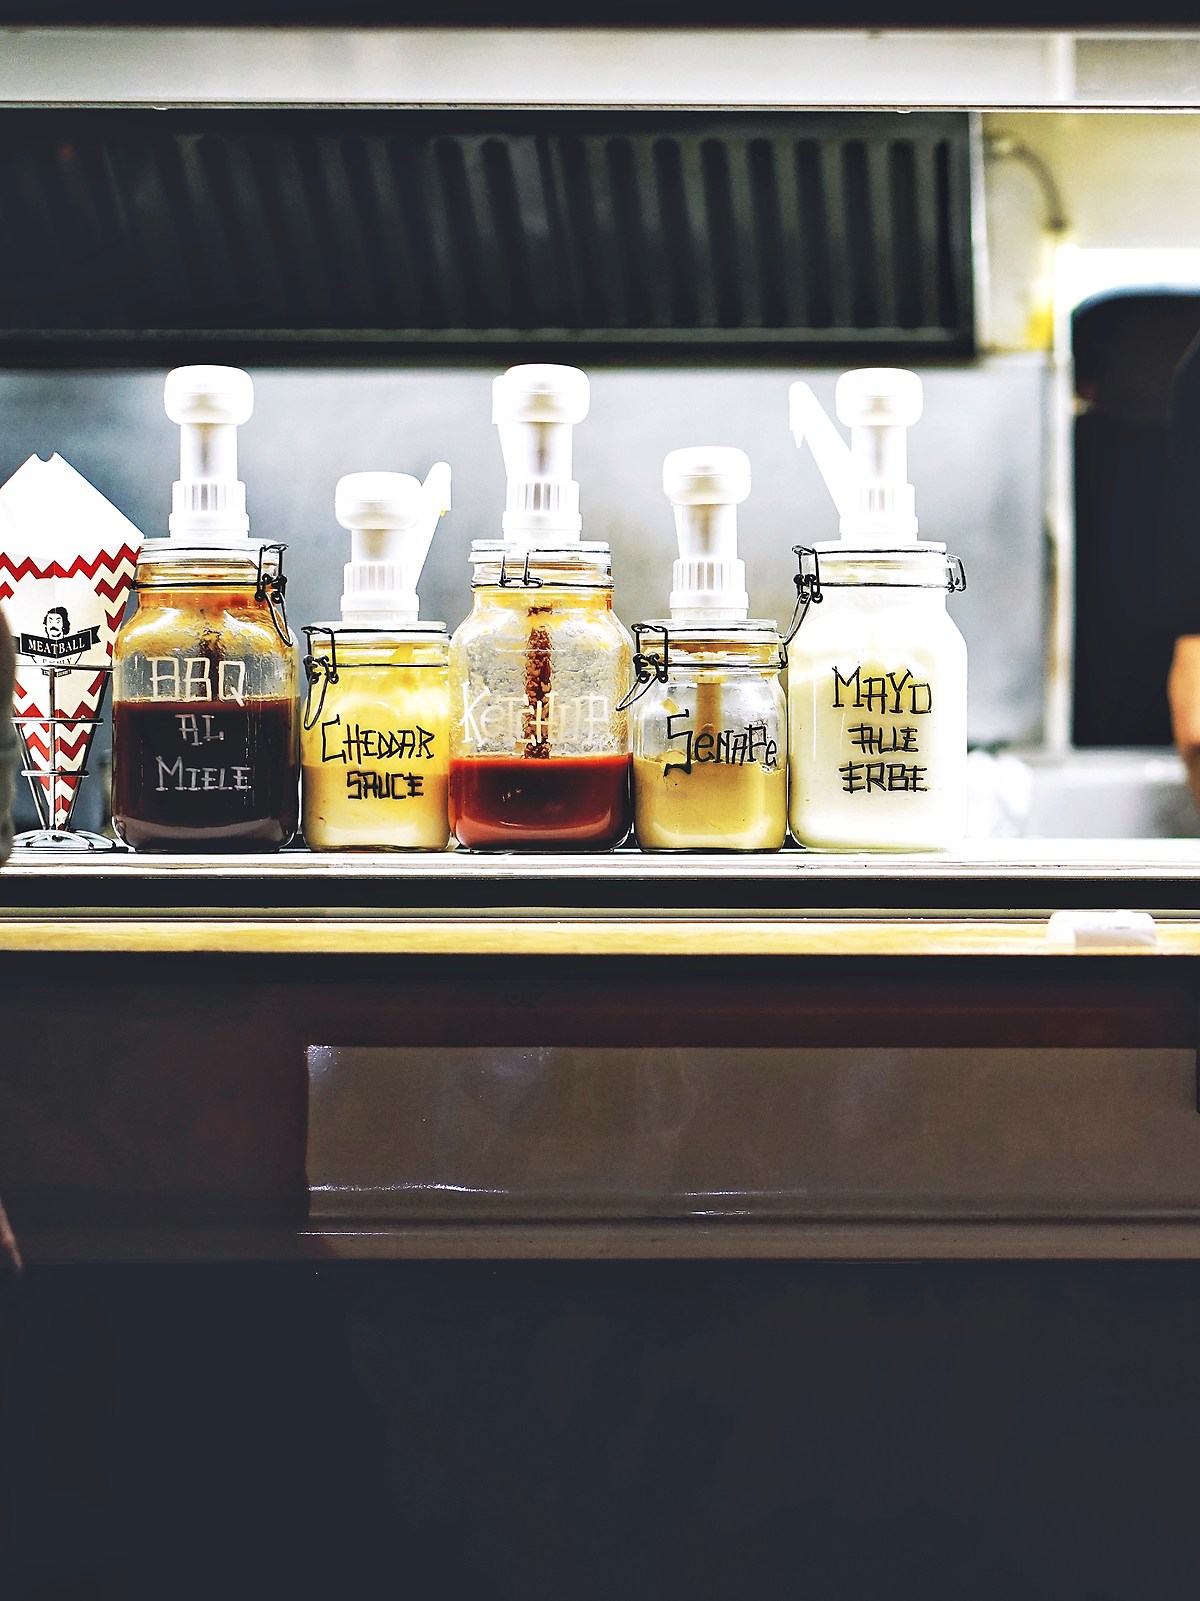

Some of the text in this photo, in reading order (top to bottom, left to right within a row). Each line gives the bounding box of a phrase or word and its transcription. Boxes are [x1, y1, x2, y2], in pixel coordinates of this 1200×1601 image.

[28, 637, 86, 655] MEATBALL
[146, 656, 246, 706] BBQ
[832, 666, 932, 714] MAYO
[175, 713, 225, 746] AL
[321, 714, 435, 764] CHEDDAR
[848, 723, 919, 754] ALLE
[155, 755, 252, 792] MIELE
[346, 771, 424, 800] SAUCE
[839, 761, 927, 794] ERBE
